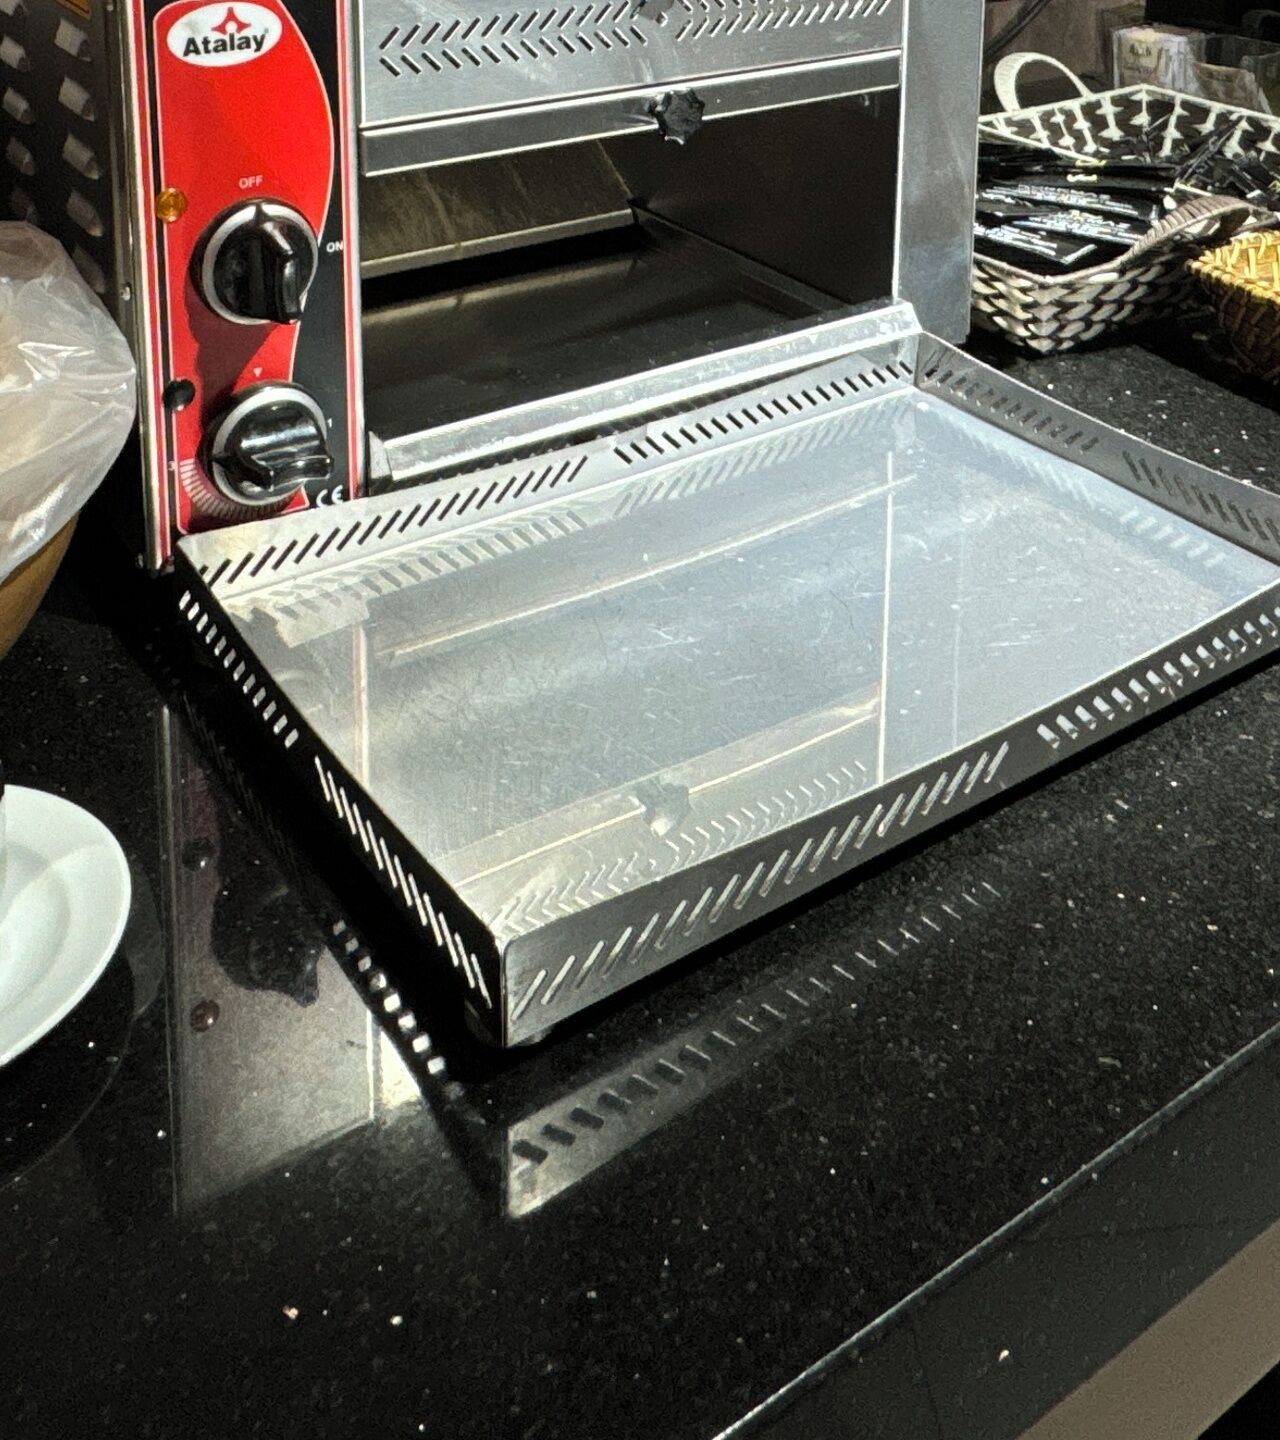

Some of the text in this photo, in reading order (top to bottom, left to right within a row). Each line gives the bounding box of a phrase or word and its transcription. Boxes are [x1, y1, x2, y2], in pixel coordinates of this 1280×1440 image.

[183, 32, 266, 57] Atalay
[238, 175, 263, 189] OFF
[326, 241, 344, 253] ON
